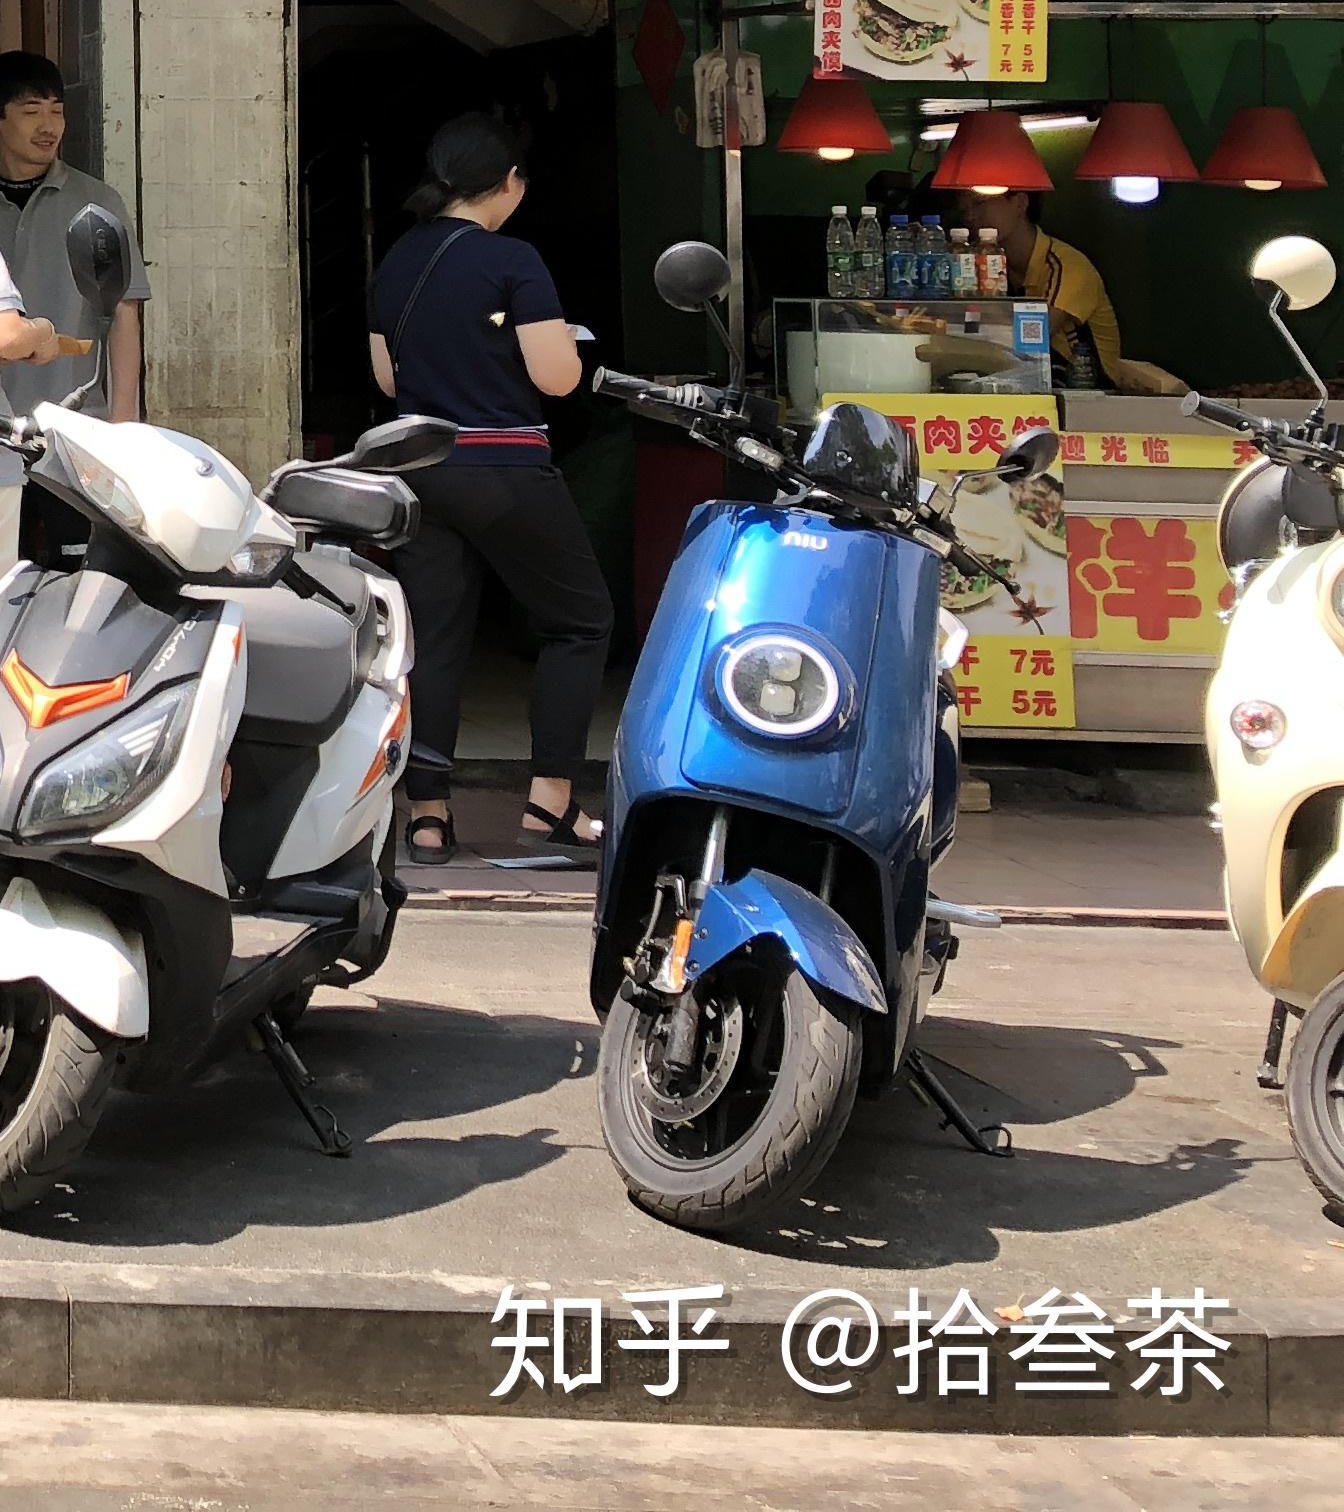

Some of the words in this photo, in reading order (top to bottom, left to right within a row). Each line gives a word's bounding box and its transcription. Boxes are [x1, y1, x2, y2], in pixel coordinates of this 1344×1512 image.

[999, 43, 1013, 73] 7元
[1021, 43, 1035, 73] 5元
[1009, 648, 1056, 677] 7元
[1011, 689, 1058, 717] 5元
